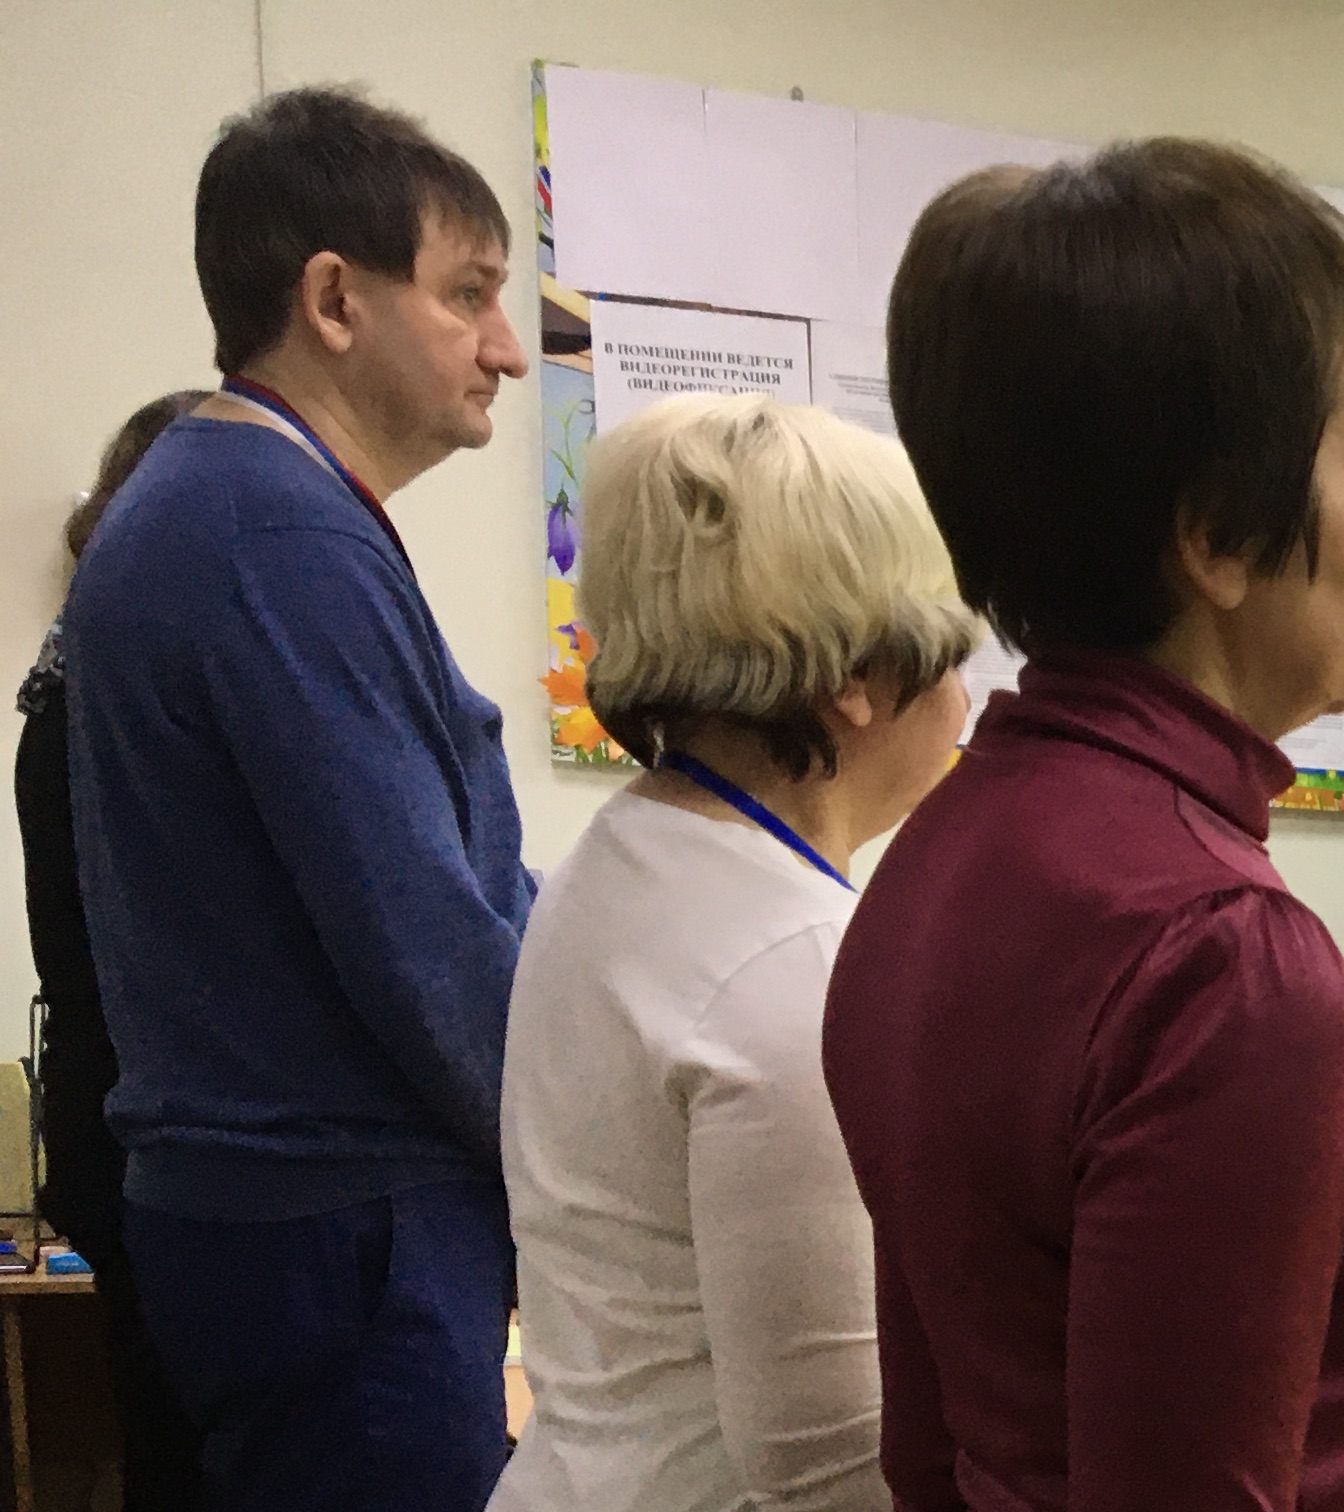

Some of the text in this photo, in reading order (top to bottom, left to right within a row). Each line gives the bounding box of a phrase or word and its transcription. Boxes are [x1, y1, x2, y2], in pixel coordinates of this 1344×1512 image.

[604, 342, 793, 369] В ПОМЕЩЕНИИ ВЕДЕТСЯ
[620, 360, 781, 385] ВИДЕОРЕГИСТРАЦИЯ
